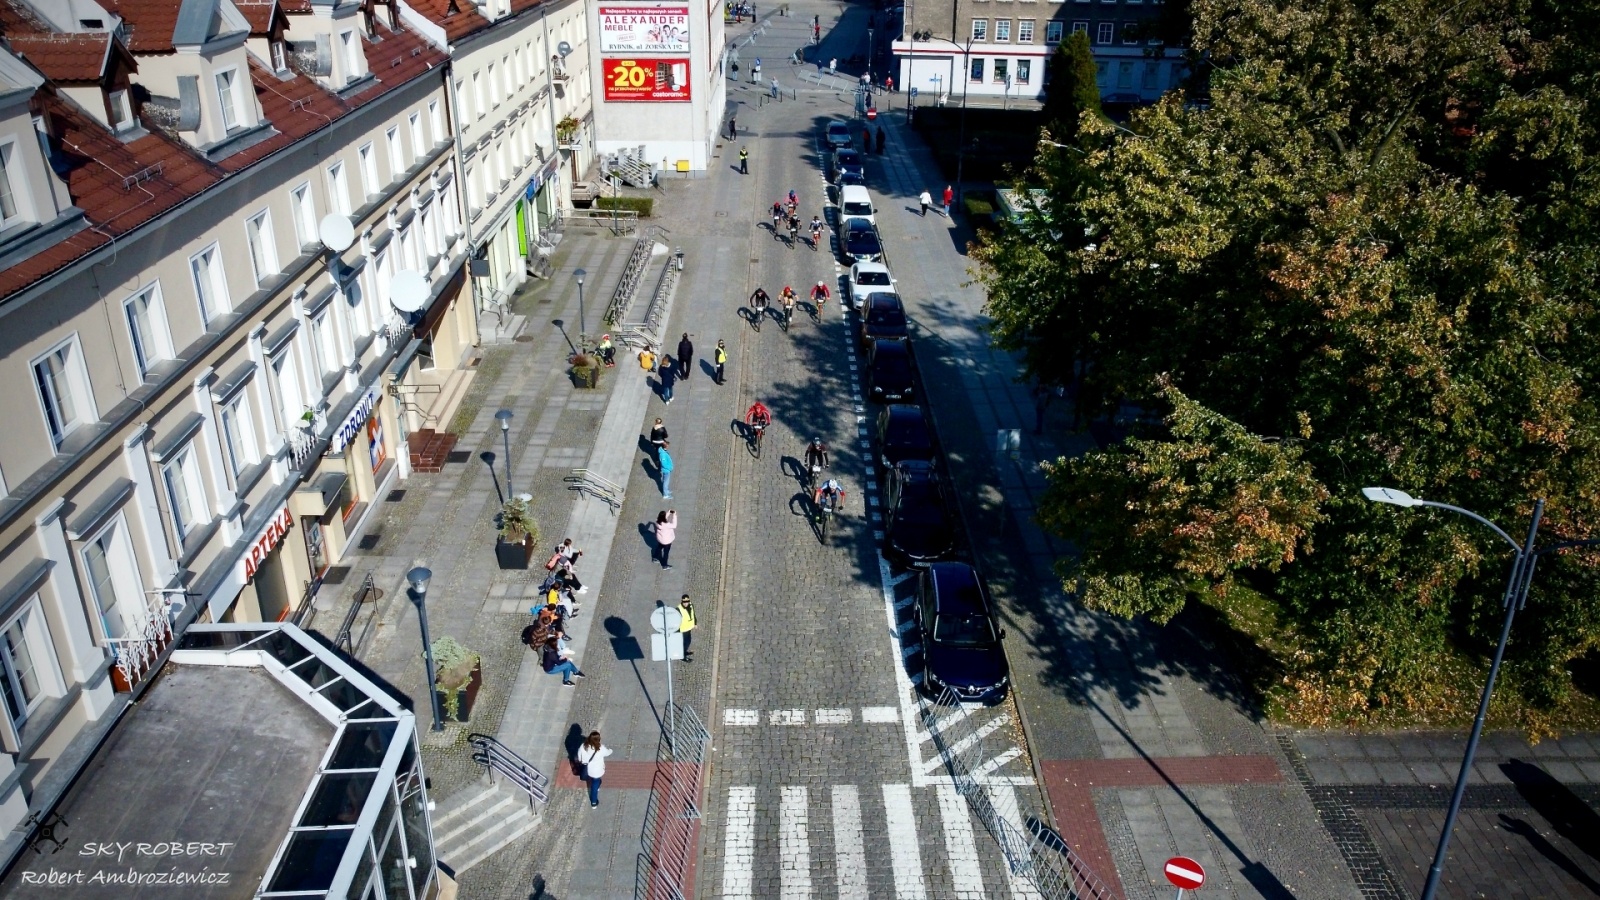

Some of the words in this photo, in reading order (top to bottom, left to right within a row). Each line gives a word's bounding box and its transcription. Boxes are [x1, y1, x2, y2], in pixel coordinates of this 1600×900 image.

[605, 16, 684, 24] ALEXANDER
[339, 391, 375, 450] ZDROWIT
[244, 506, 294, 583] APTEKA
